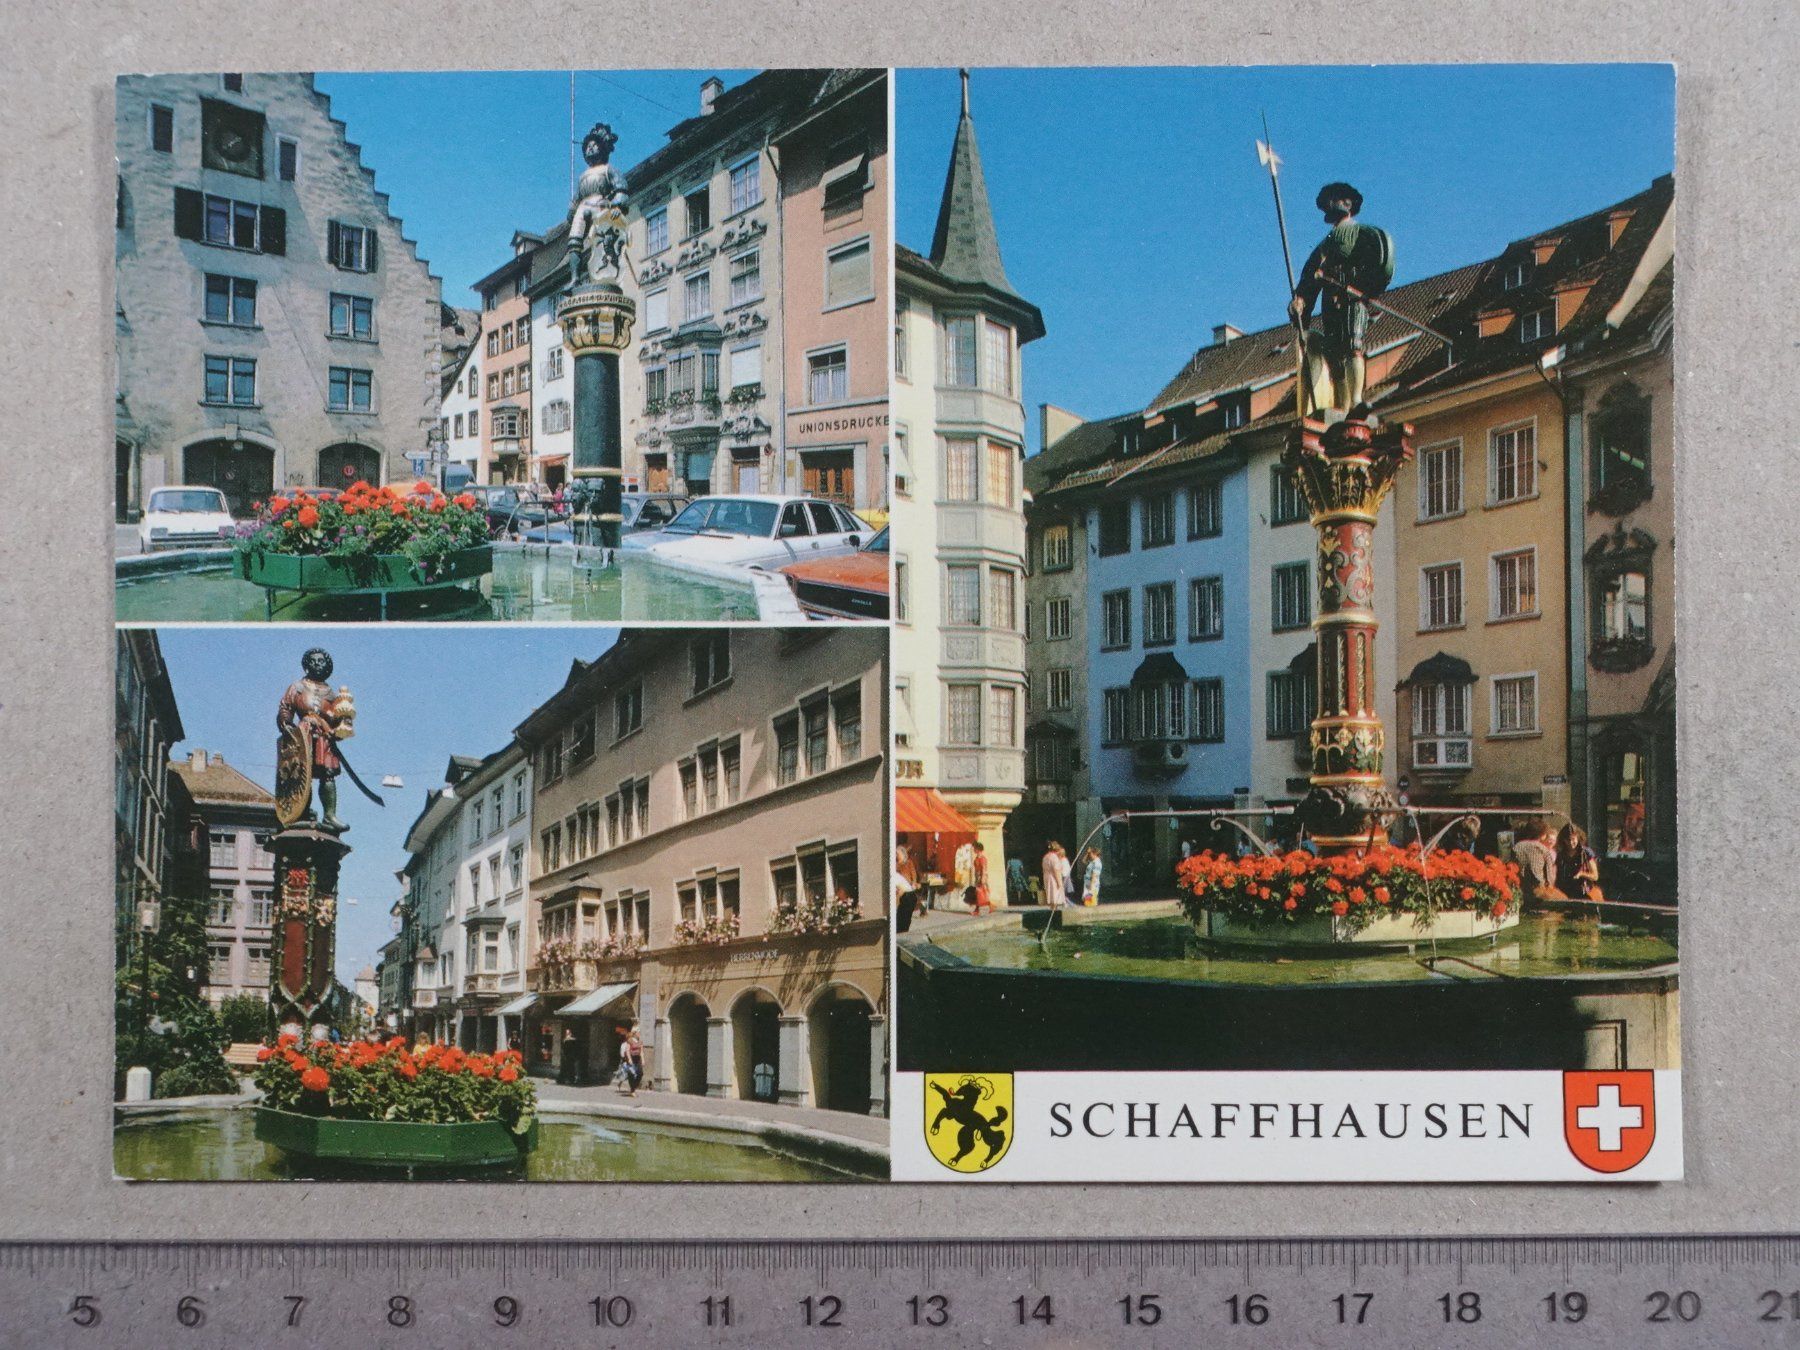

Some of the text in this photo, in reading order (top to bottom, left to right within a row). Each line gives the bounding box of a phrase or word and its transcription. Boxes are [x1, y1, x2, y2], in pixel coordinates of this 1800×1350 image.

[799, 415, 890, 434] UNIONSDRUCKE
[1050, 1102, 1532, 1139] SCHAFFHAUSEN
[72, 1296, 98, 1327] 5
[177, 1296, 205, 1328] 6
[283, 1296, 307, 1327] 7
[387, 1295, 413, 1328] 8
[493, 1296, 519, 1327] 9
[590, 1295, 634, 1327] 10
[700, 1295, 731, 1327] 11
[800, 1295, 842, 1327] 12
[906, 1295, 949, 1327] 13
[1013, 1295, 1055, 1326] 14
[1118, 1295, 1161, 1326] 15
[1225, 1294, 1269, 1325] 16
[1332, 1293, 1373, 1324] 17
[1437, 1292, 1482, 1324] 18
[1543, 1292, 1588, 1324] 19
[1647, 1291, 1701, 1322] 20
